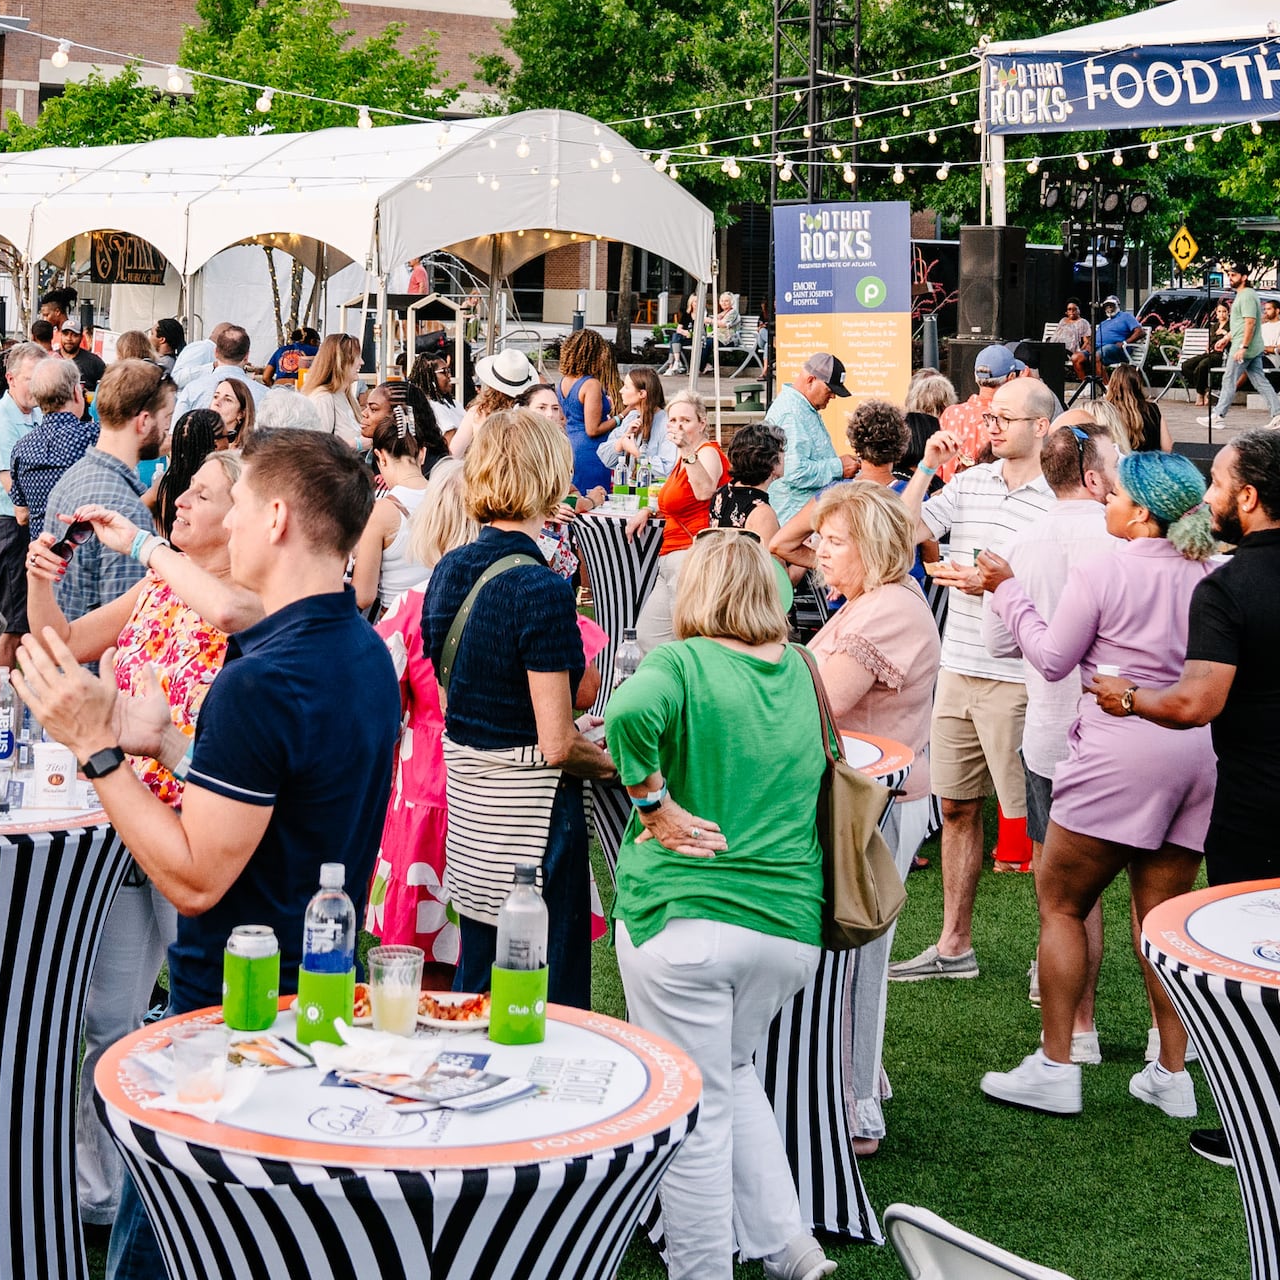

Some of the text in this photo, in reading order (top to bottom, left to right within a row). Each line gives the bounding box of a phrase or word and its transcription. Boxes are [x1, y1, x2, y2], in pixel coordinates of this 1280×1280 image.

[1027, 61, 1064, 89] THAT
[1083, 58, 1220, 112] FOOD
[989, 87, 1069, 125] ROCKS
[830, 210, 872, 231] THAT
[800, 230, 873, 261] ROCKS
[792, 281, 818, 291] EMORY
[792, 298, 820, 306] HOSPITAL
[507, 1004, 529, 1015] Club
[531, 1127, 605, 1152] FOUR
